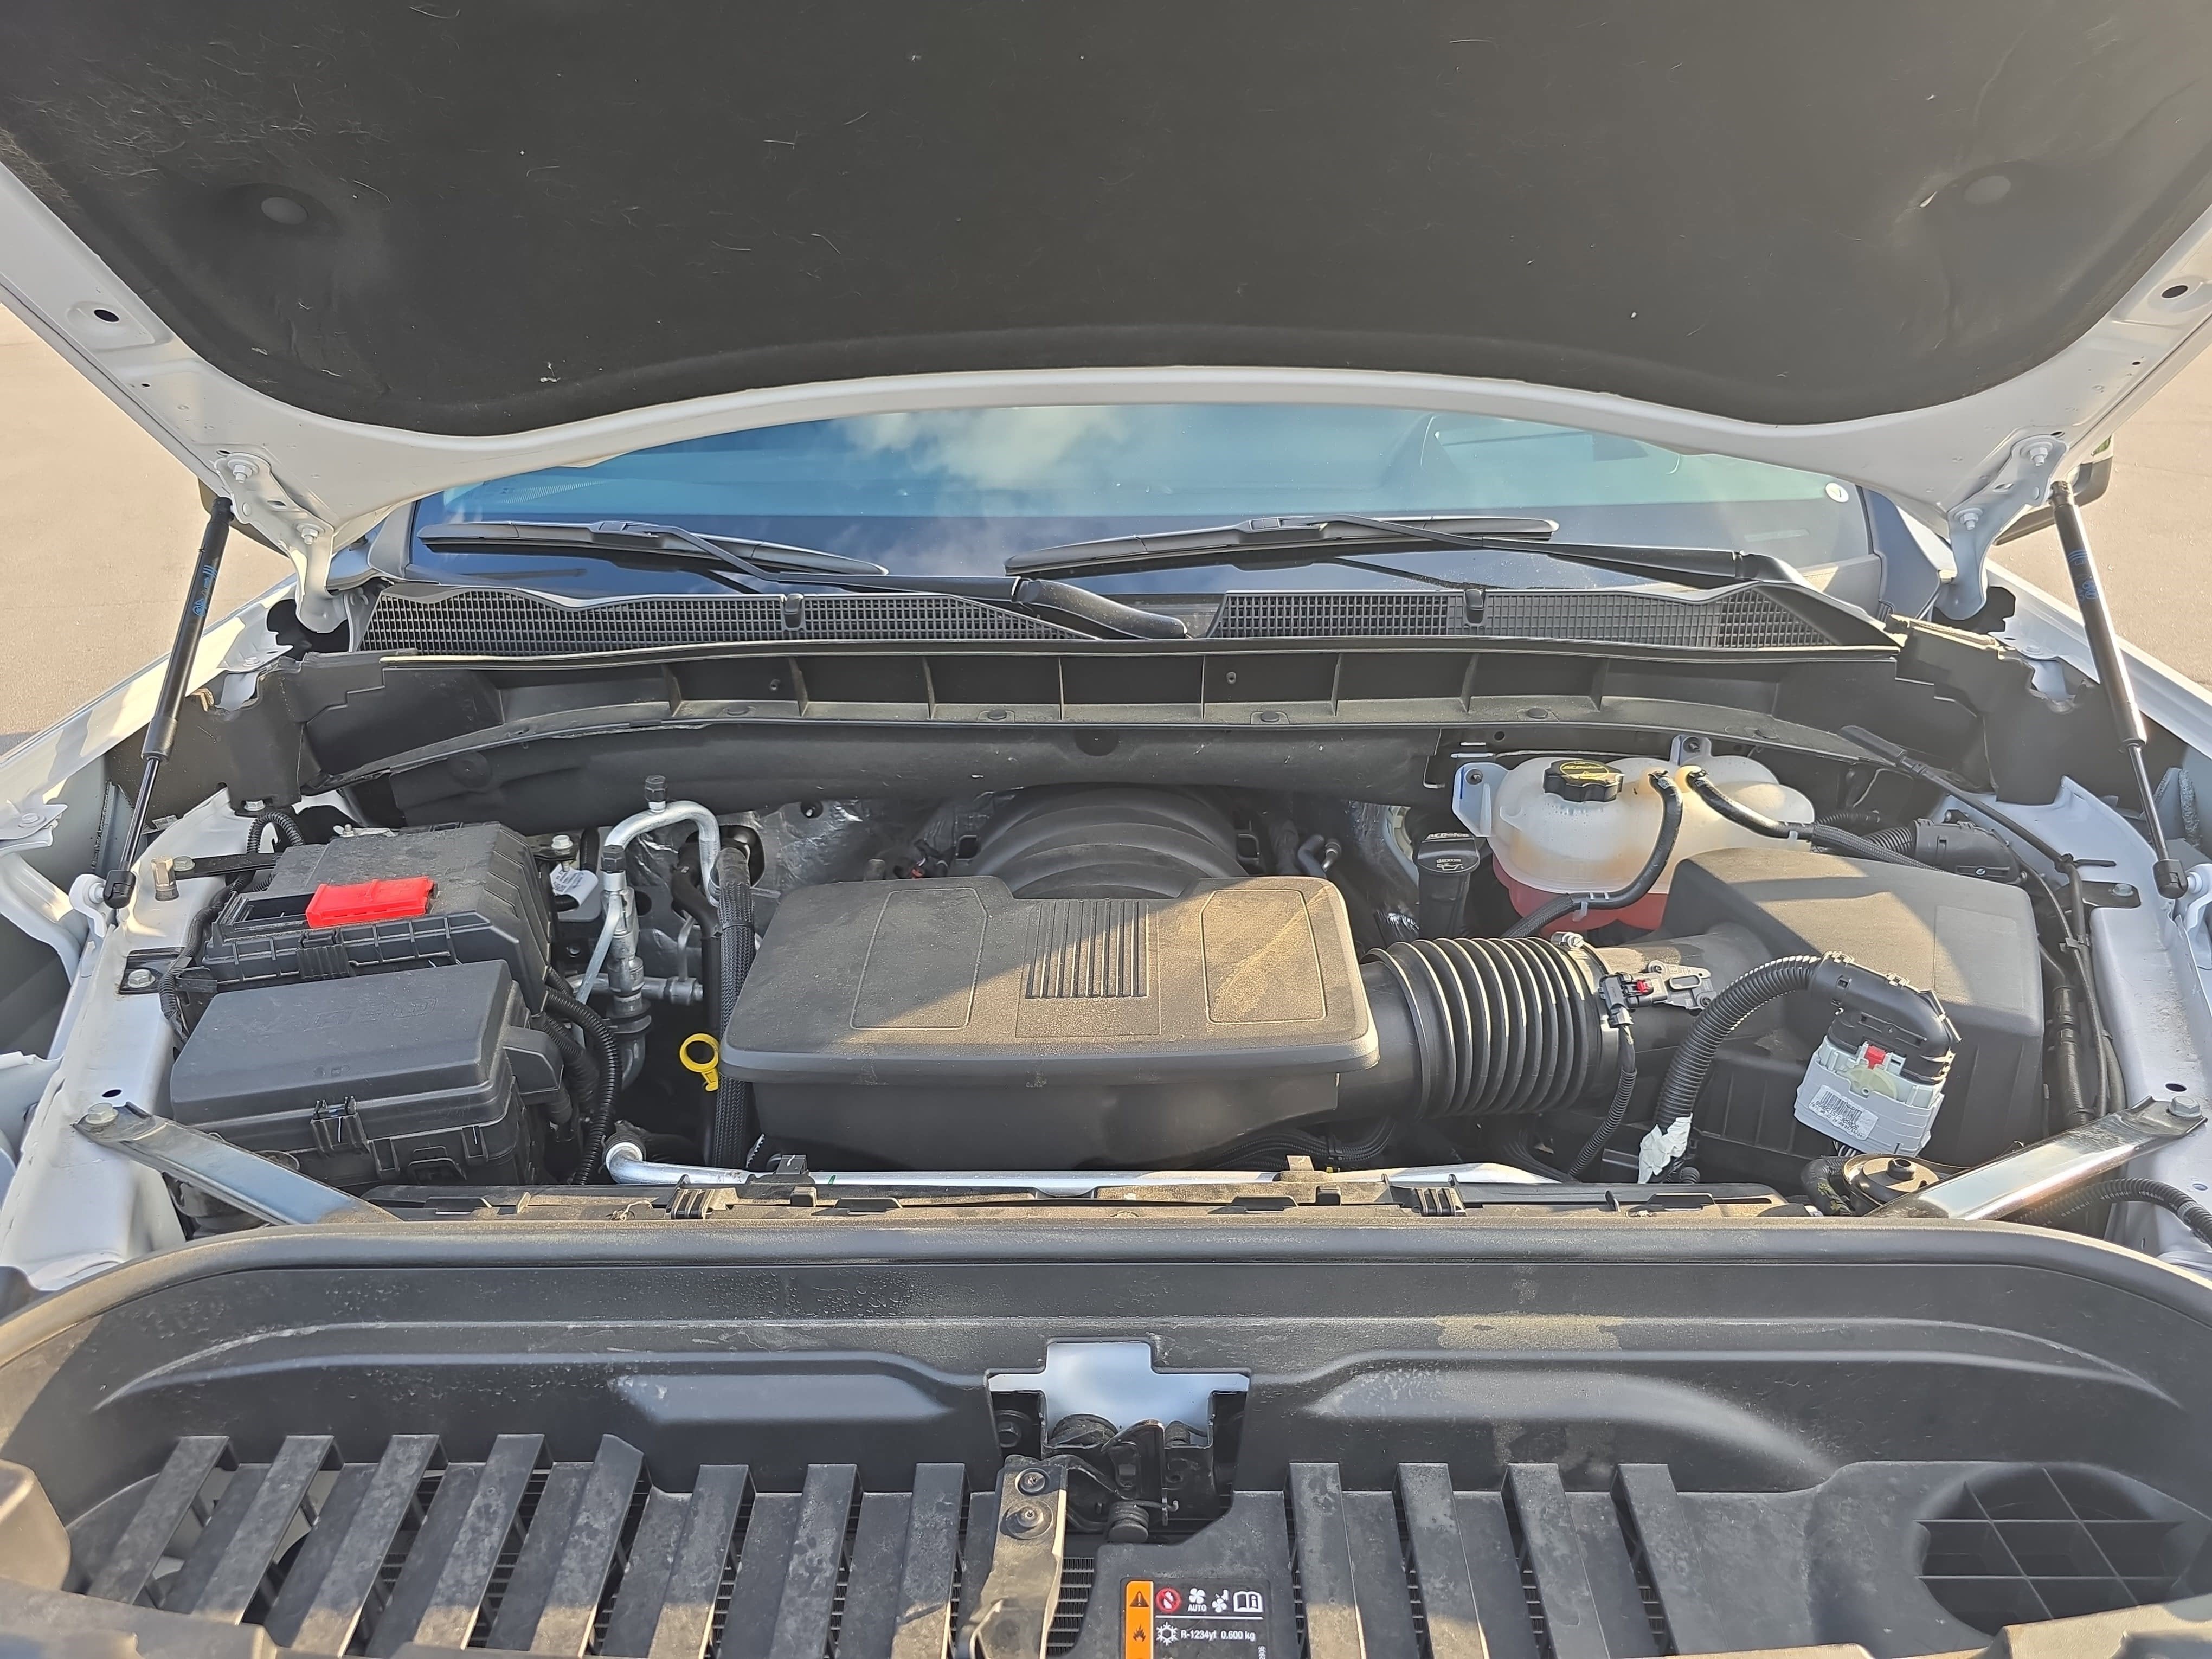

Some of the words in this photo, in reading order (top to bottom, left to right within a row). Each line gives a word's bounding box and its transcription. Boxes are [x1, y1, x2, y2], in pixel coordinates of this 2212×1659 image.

[1187, 1604, 1207, 1612] AUTO
[1180, 1629, 1217, 1642] R-1234yf
[1245, 1630, 1256, 1642] kg
